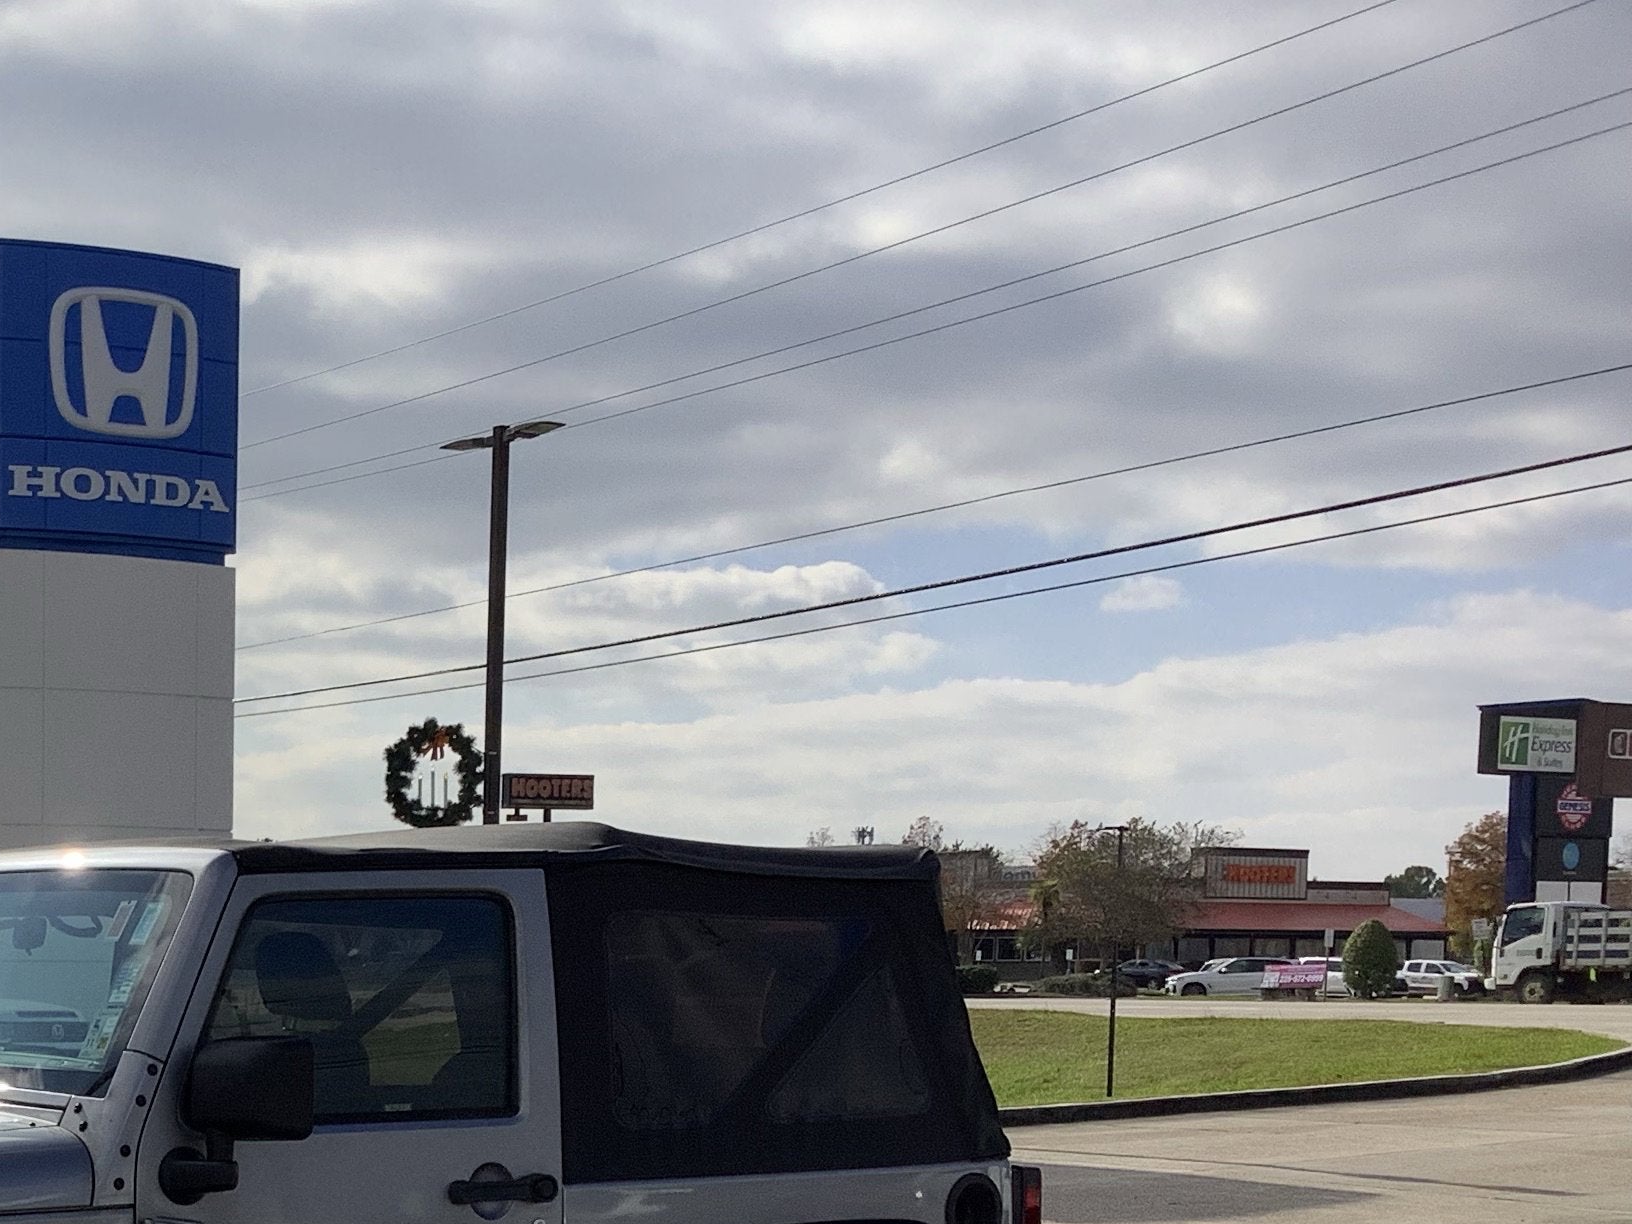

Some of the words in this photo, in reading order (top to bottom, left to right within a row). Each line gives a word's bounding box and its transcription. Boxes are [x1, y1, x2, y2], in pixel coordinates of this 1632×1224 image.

[8, 464, 230, 512] HONDA
[1531, 736, 1572, 756] Express
[510, 777, 593, 798] HOOTERS
[1559, 801, 1590, 811] GENESIS
